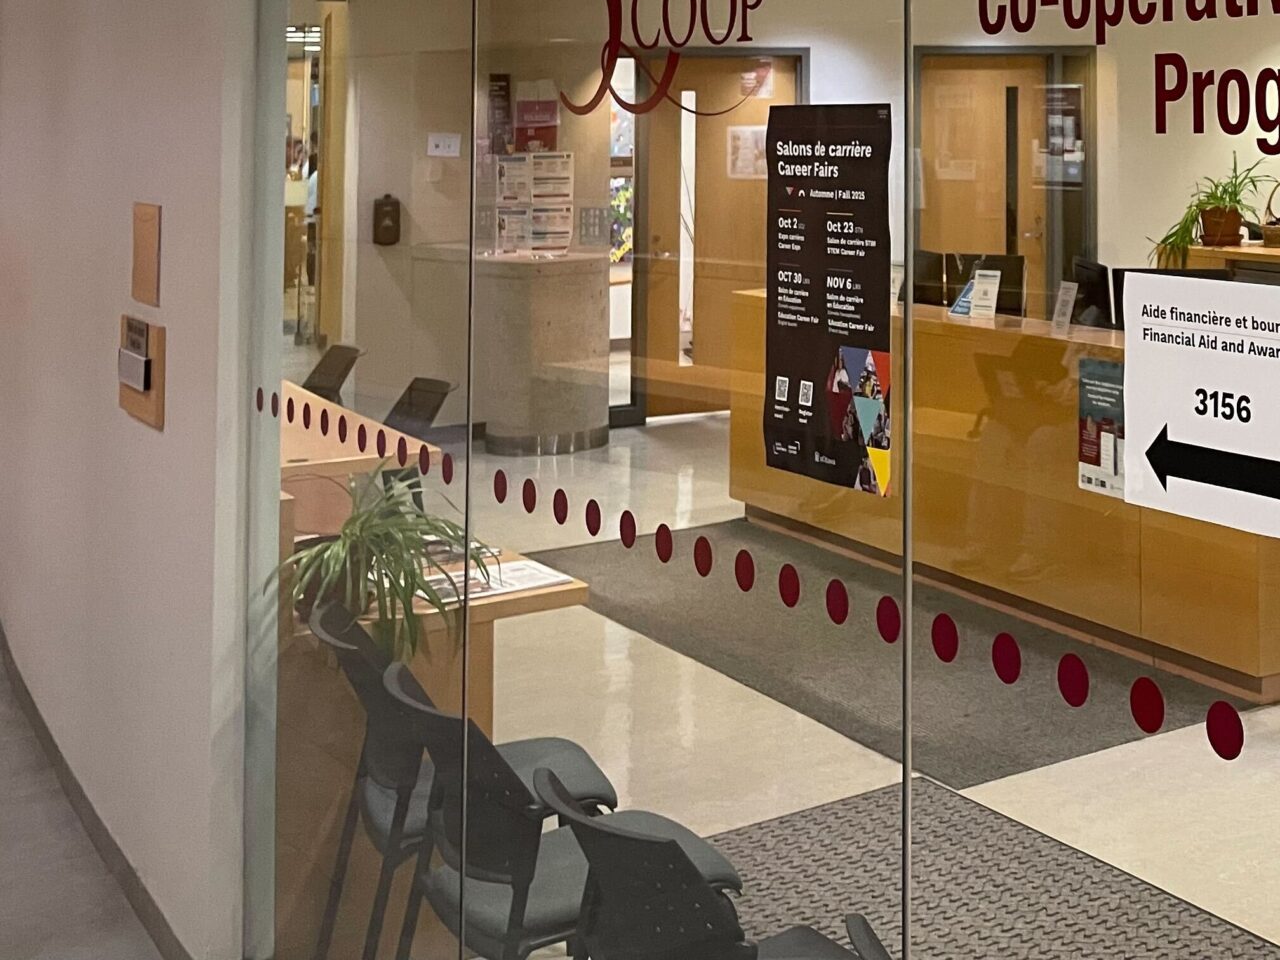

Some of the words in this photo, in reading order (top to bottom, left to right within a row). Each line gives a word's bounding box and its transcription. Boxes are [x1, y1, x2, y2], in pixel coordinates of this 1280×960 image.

[776, 141, 812, 156] Salons
[815, 141, 825, 156] de
[829, 141, 872, 158] carrière
[778, 161, 812, 177] Career
[814, 162, 838, 178] Fairs
[778, 218, 791, 228] Oct
[793, 218, 797, 228] 2
[827, 221, 841, 232] Oct
[844, 222, 854, 233] 23
[778, 271, 791, 283] OCT
[793, 272, 802, 284] 30
[827, 277, 844, 289] NOV
[847, 279, 852, 290] 6
[1142, 304, 1166, 319] Aide
[1170, 307, 1231, 327] financière
[1235, 318, 1248, 329] et
[1143, 328, 1195, 348] Financial
[1199, 335, 1217, 350] Aid
[1221, 340, 1244, 354] and
[1194, 388, 1251, 423] 3156
